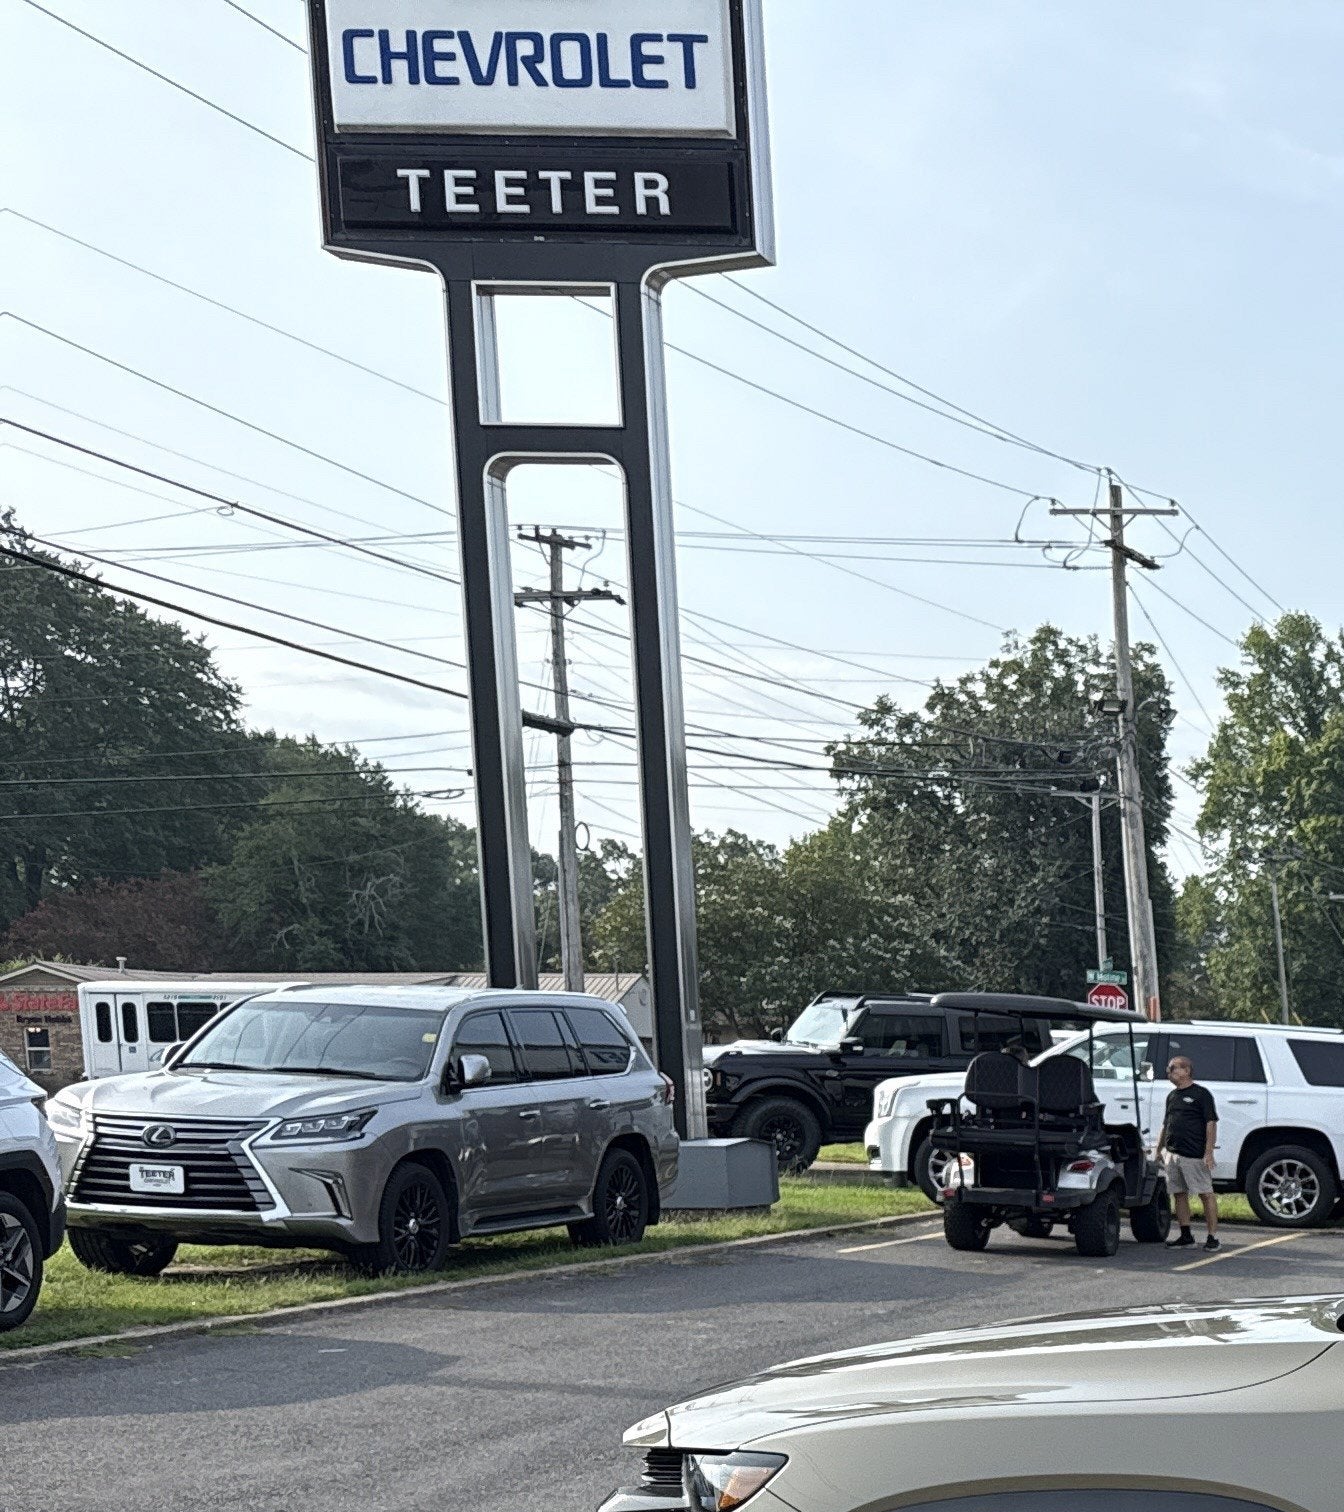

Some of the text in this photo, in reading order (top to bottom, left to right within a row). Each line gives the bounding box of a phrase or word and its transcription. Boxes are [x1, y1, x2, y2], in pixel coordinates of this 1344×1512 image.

[342, 29, 709, 89] CHEVROLET
[397, 168, 671, 216] TEETER
[1091, 995, 1126, 1009] STOP
[139, 1166, 176, 1181] TEETER
